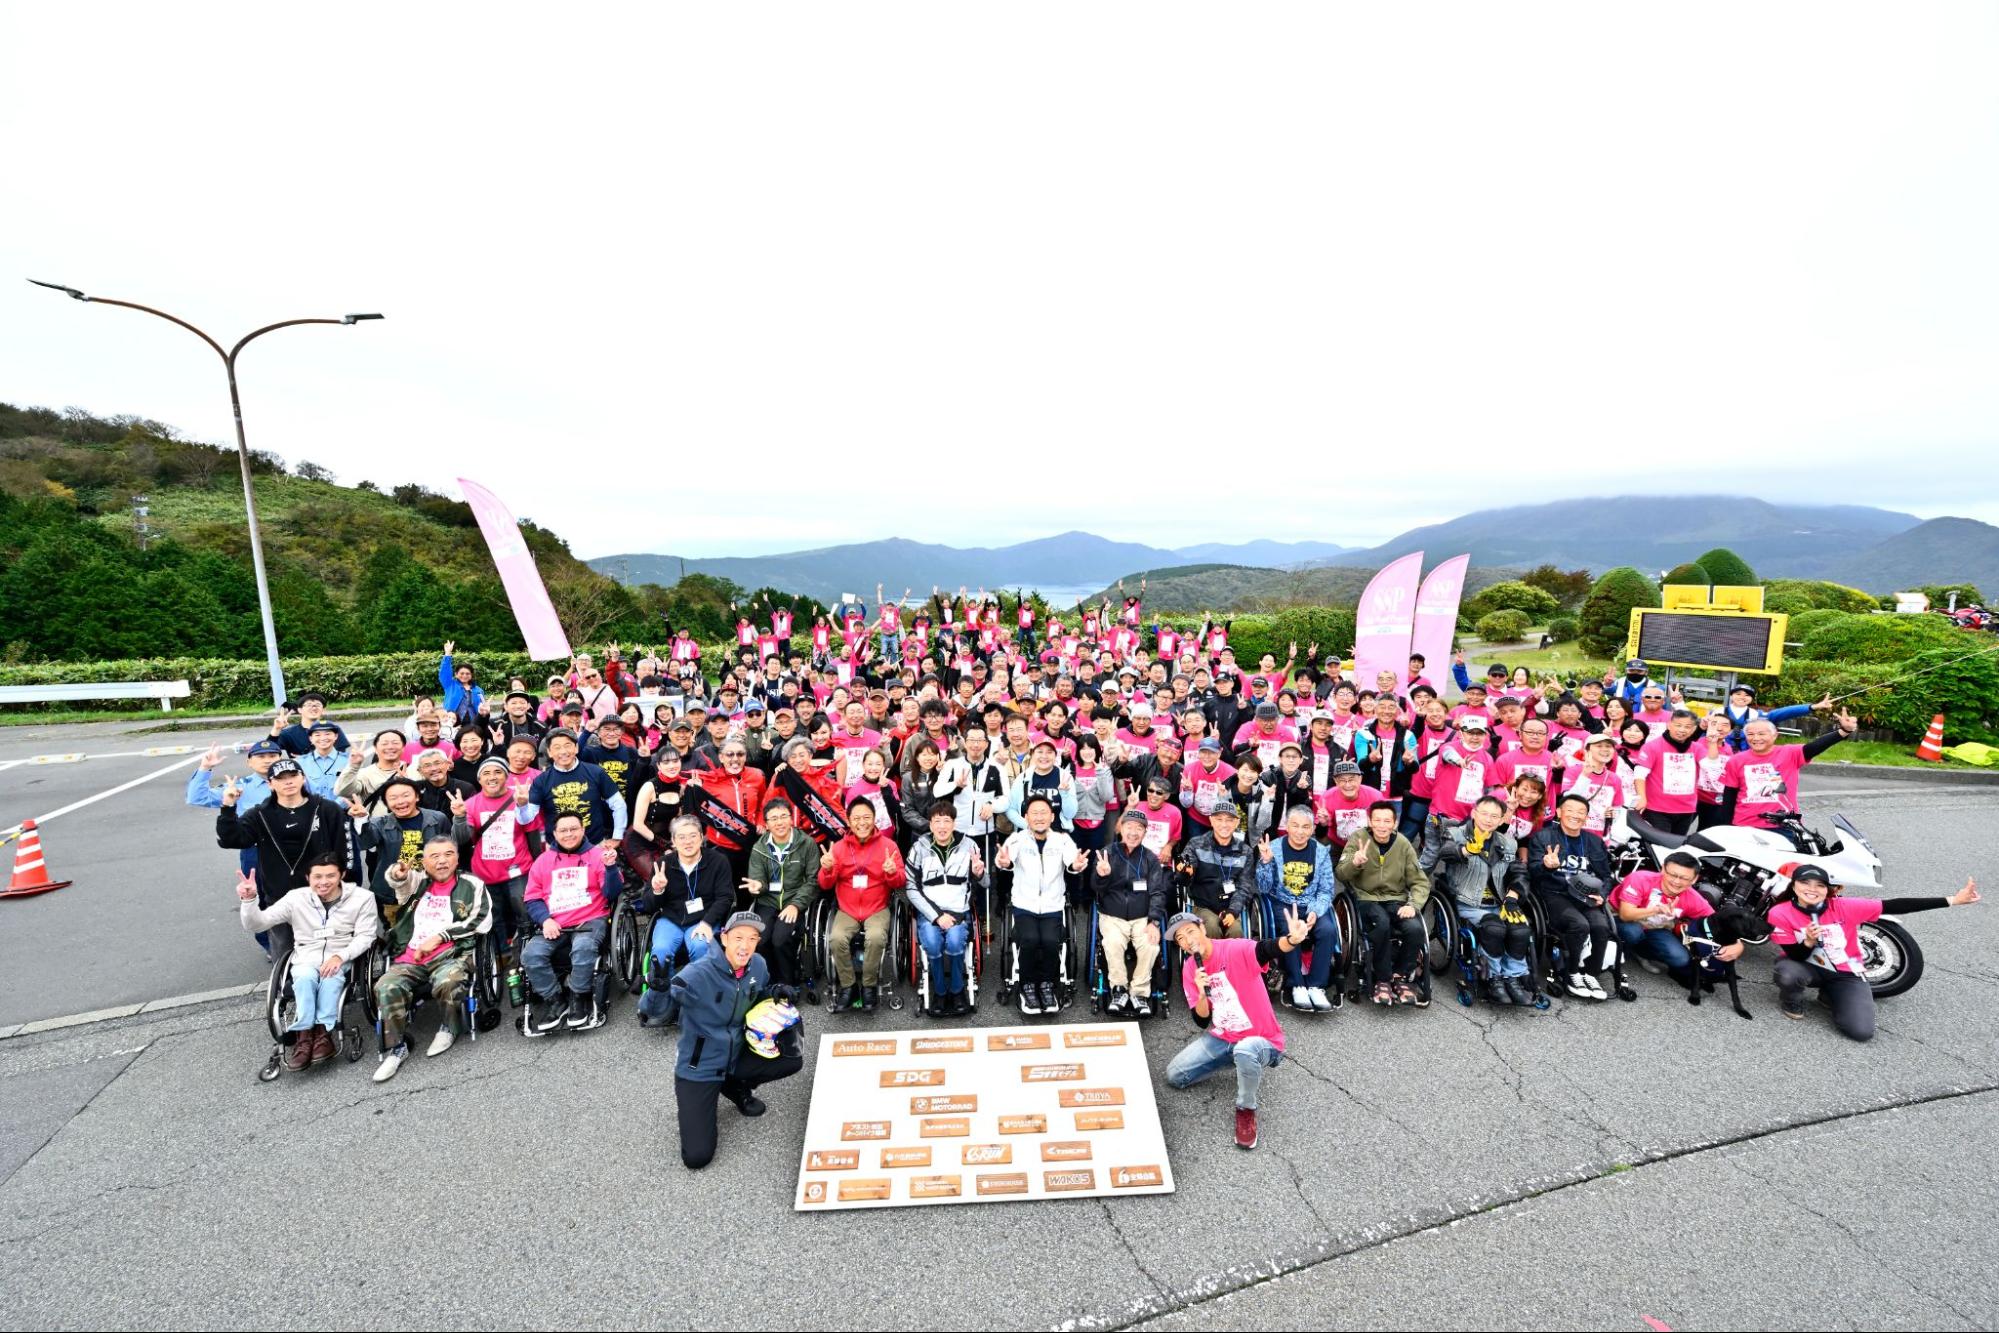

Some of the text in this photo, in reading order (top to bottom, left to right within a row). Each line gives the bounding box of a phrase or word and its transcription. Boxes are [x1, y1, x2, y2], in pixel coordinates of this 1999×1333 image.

[838, 1042, 891, 1053] Auto Race
[894, 1071, 932, 1083] SDG
[931, 1103, 973, 1112] MOTORRAD
